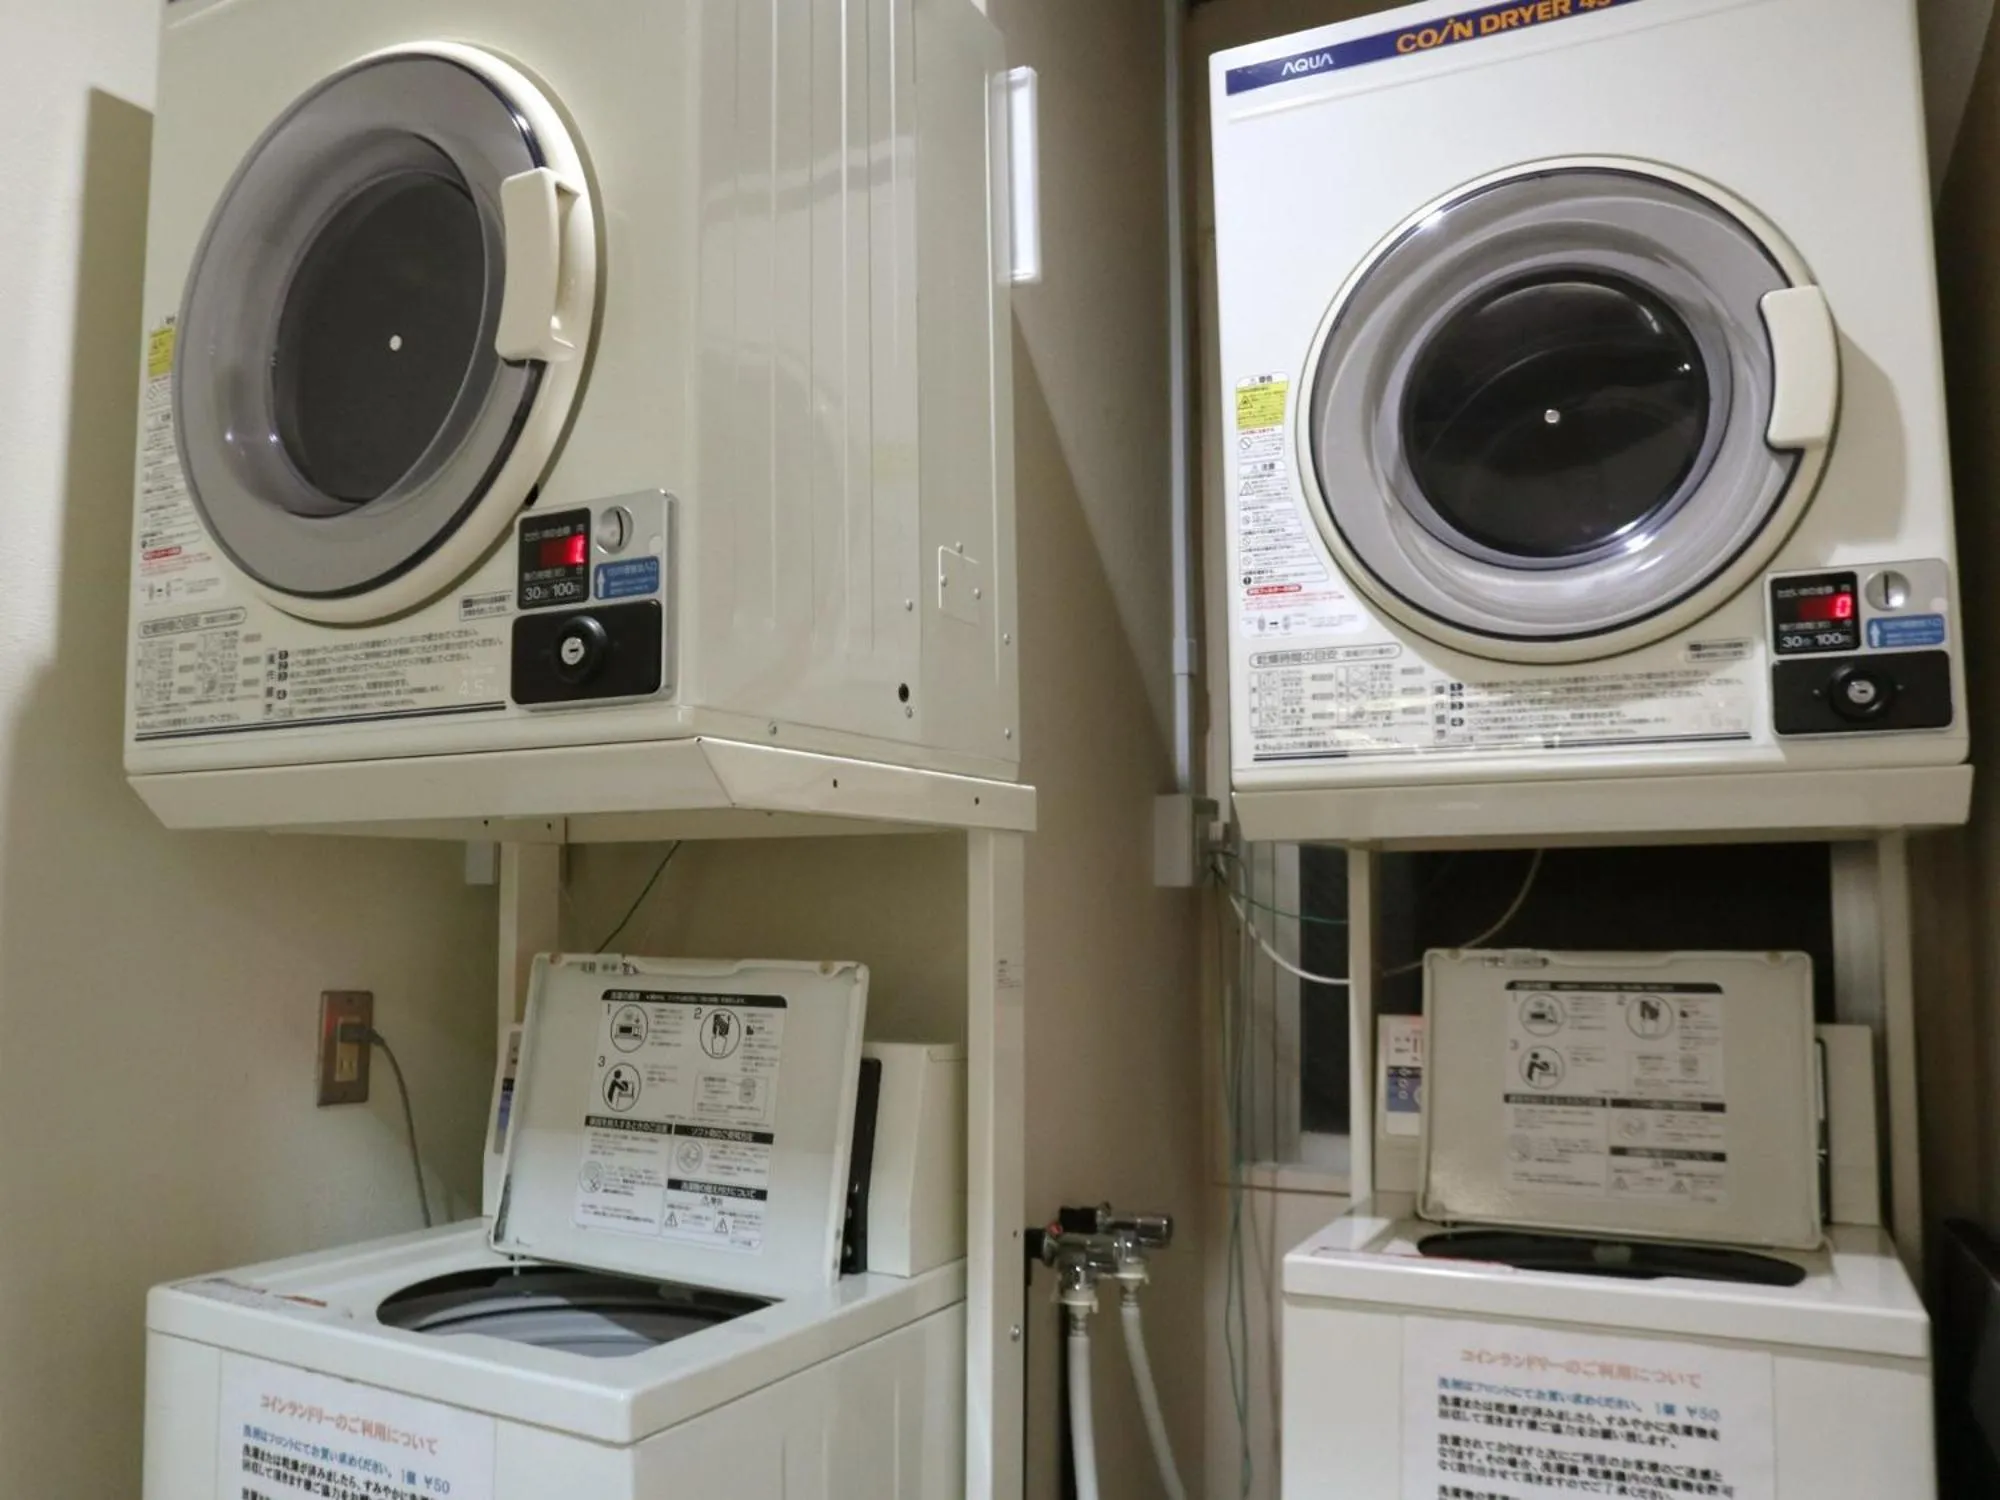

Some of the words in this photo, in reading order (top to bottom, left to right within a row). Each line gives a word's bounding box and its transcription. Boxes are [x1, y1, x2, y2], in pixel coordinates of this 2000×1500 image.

[1480, 0, 1571, 35] DRYER
[1281, 52, 1334, 76] AQUA
[1836, 595, 1852, 618] 0
[694, 1007, 702, 1020] 2
[597, 1055, 606, 1068] 3
[1460, 1348, 1702, 1389] コインランドリーのご利用について
[260, 1392, 439, 1455] コインランドリーのご利用について
